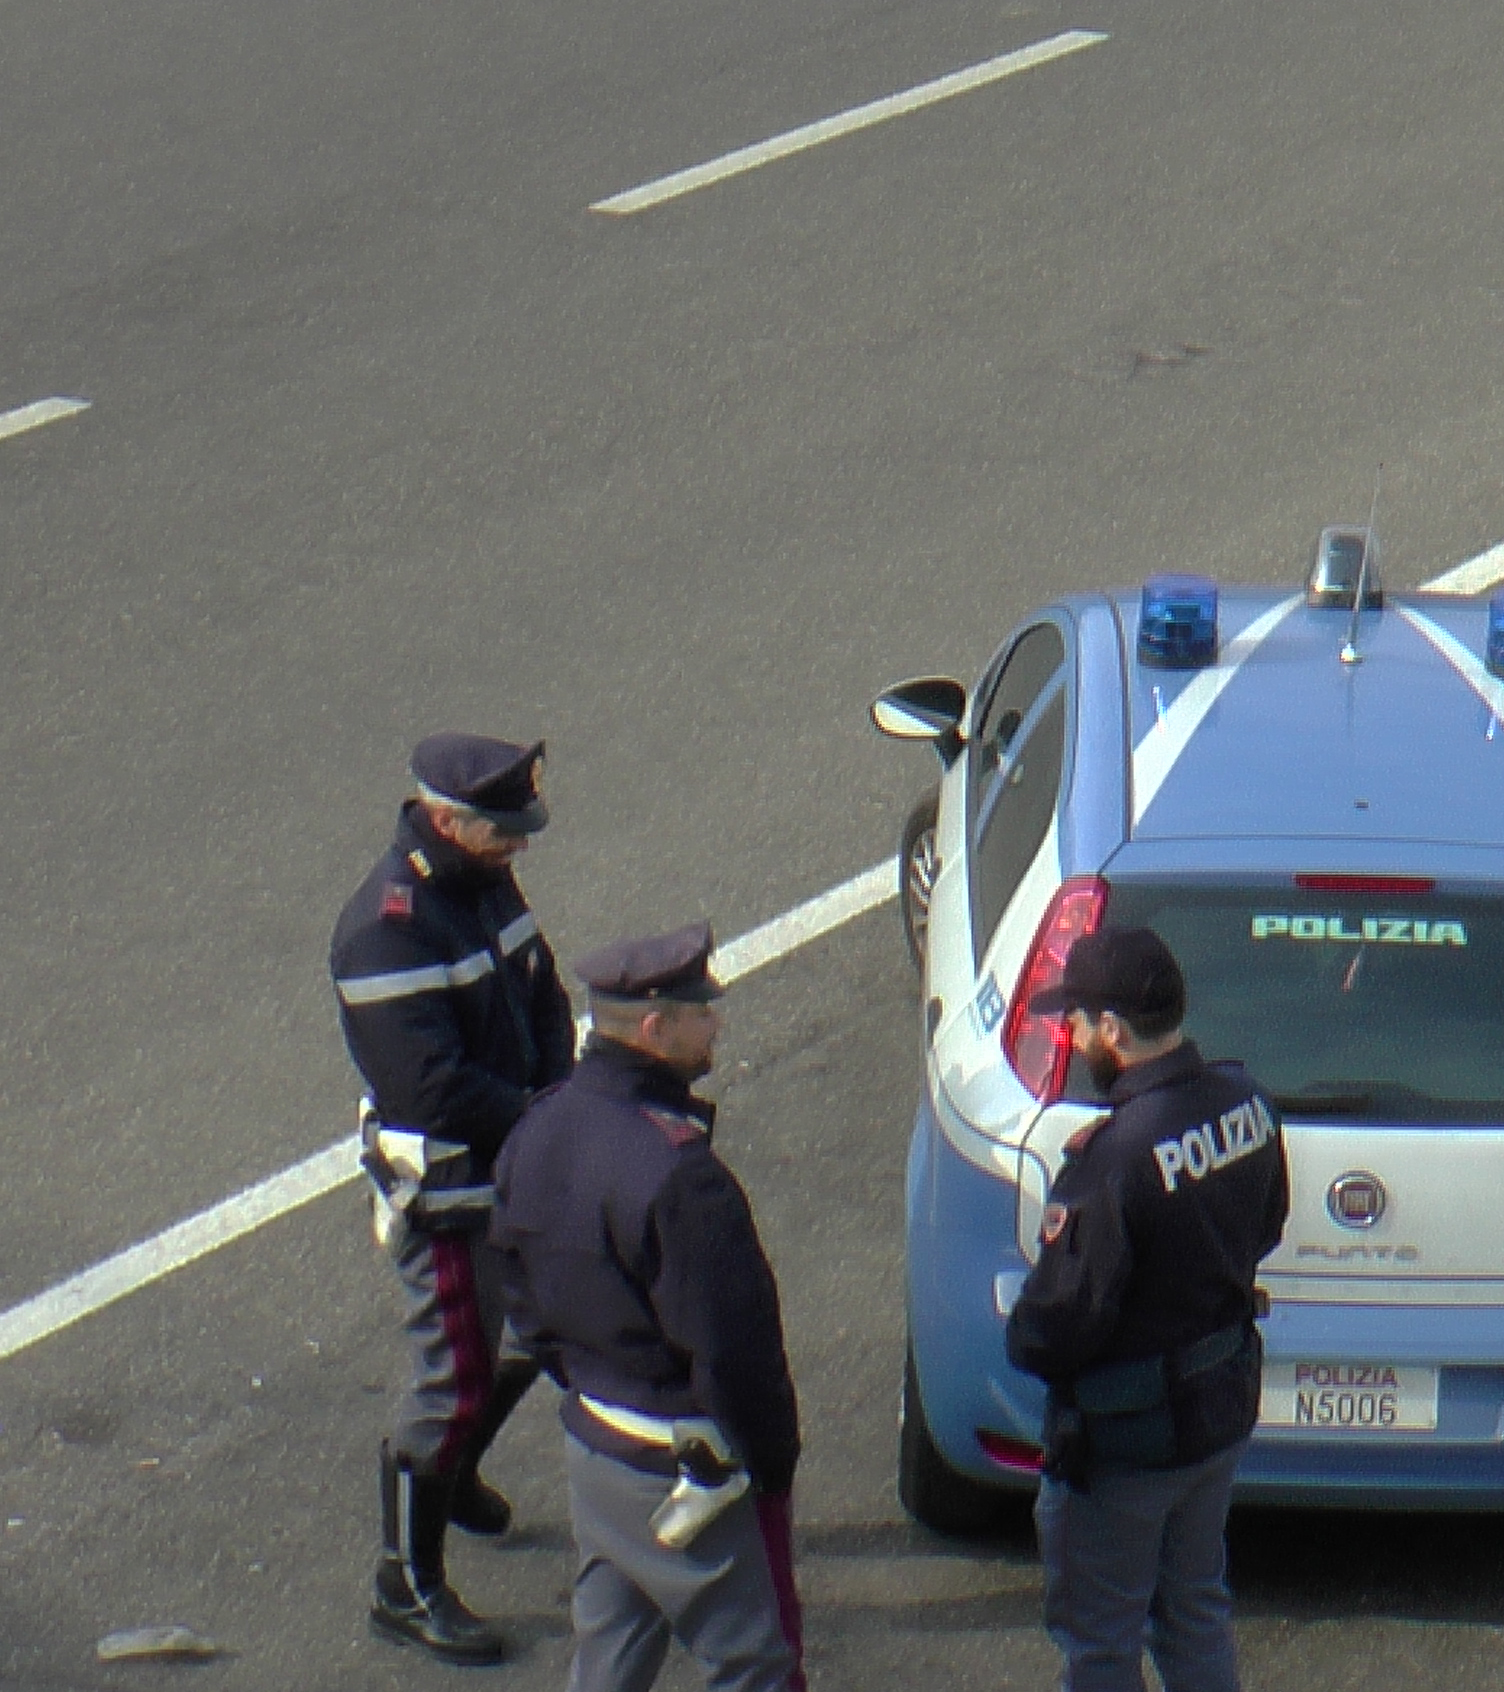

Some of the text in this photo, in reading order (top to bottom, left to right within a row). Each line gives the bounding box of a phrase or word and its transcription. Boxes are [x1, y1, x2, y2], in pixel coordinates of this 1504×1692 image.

[1251, 914, 1468, 945] POLIZIA
[1153, 1094, 1276, 1192] POLIZIA
[1297, 1364, 1398, 1388] POLIZIA
[1297, 1391, 1396, 1425] N5006
